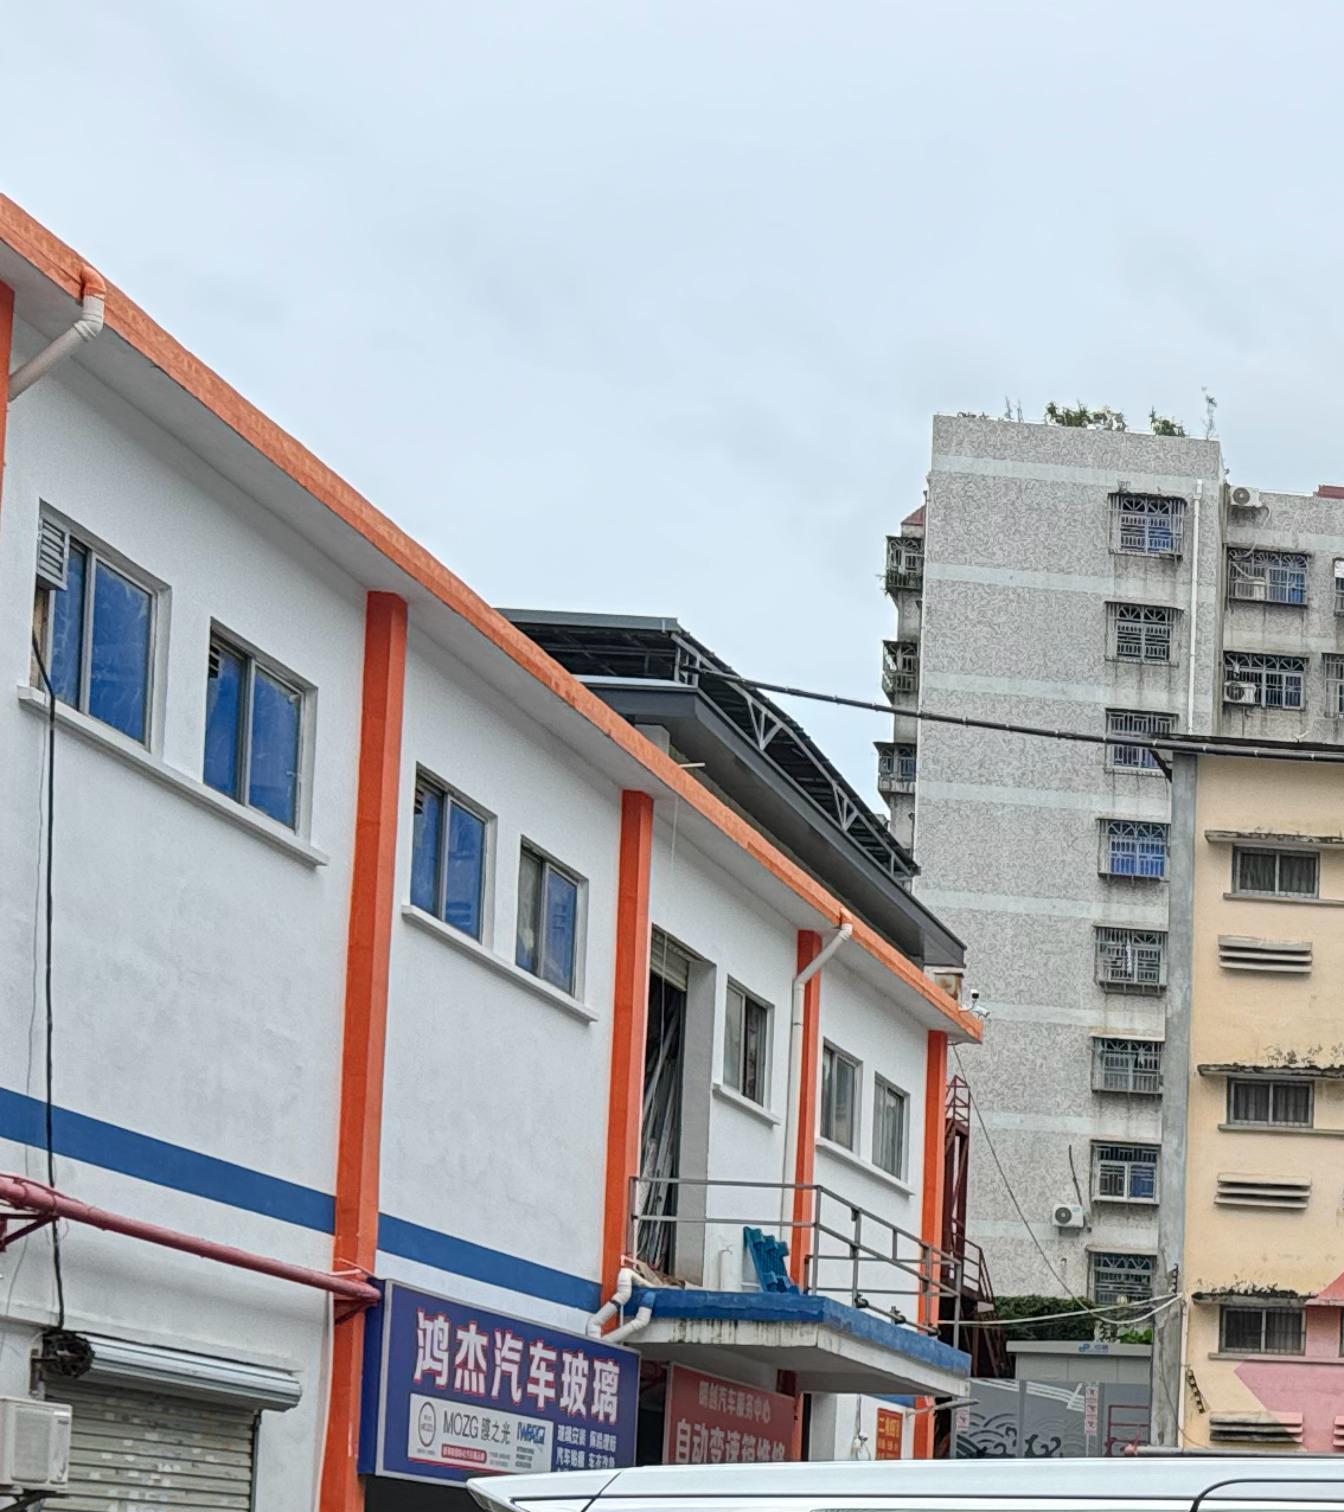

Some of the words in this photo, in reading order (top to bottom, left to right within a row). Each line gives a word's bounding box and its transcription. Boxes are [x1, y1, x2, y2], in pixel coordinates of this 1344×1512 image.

[413, 1307, 620, 1425] 鸿杰汽车玻璃
[443, 1410, 479, 1439] MOZG
